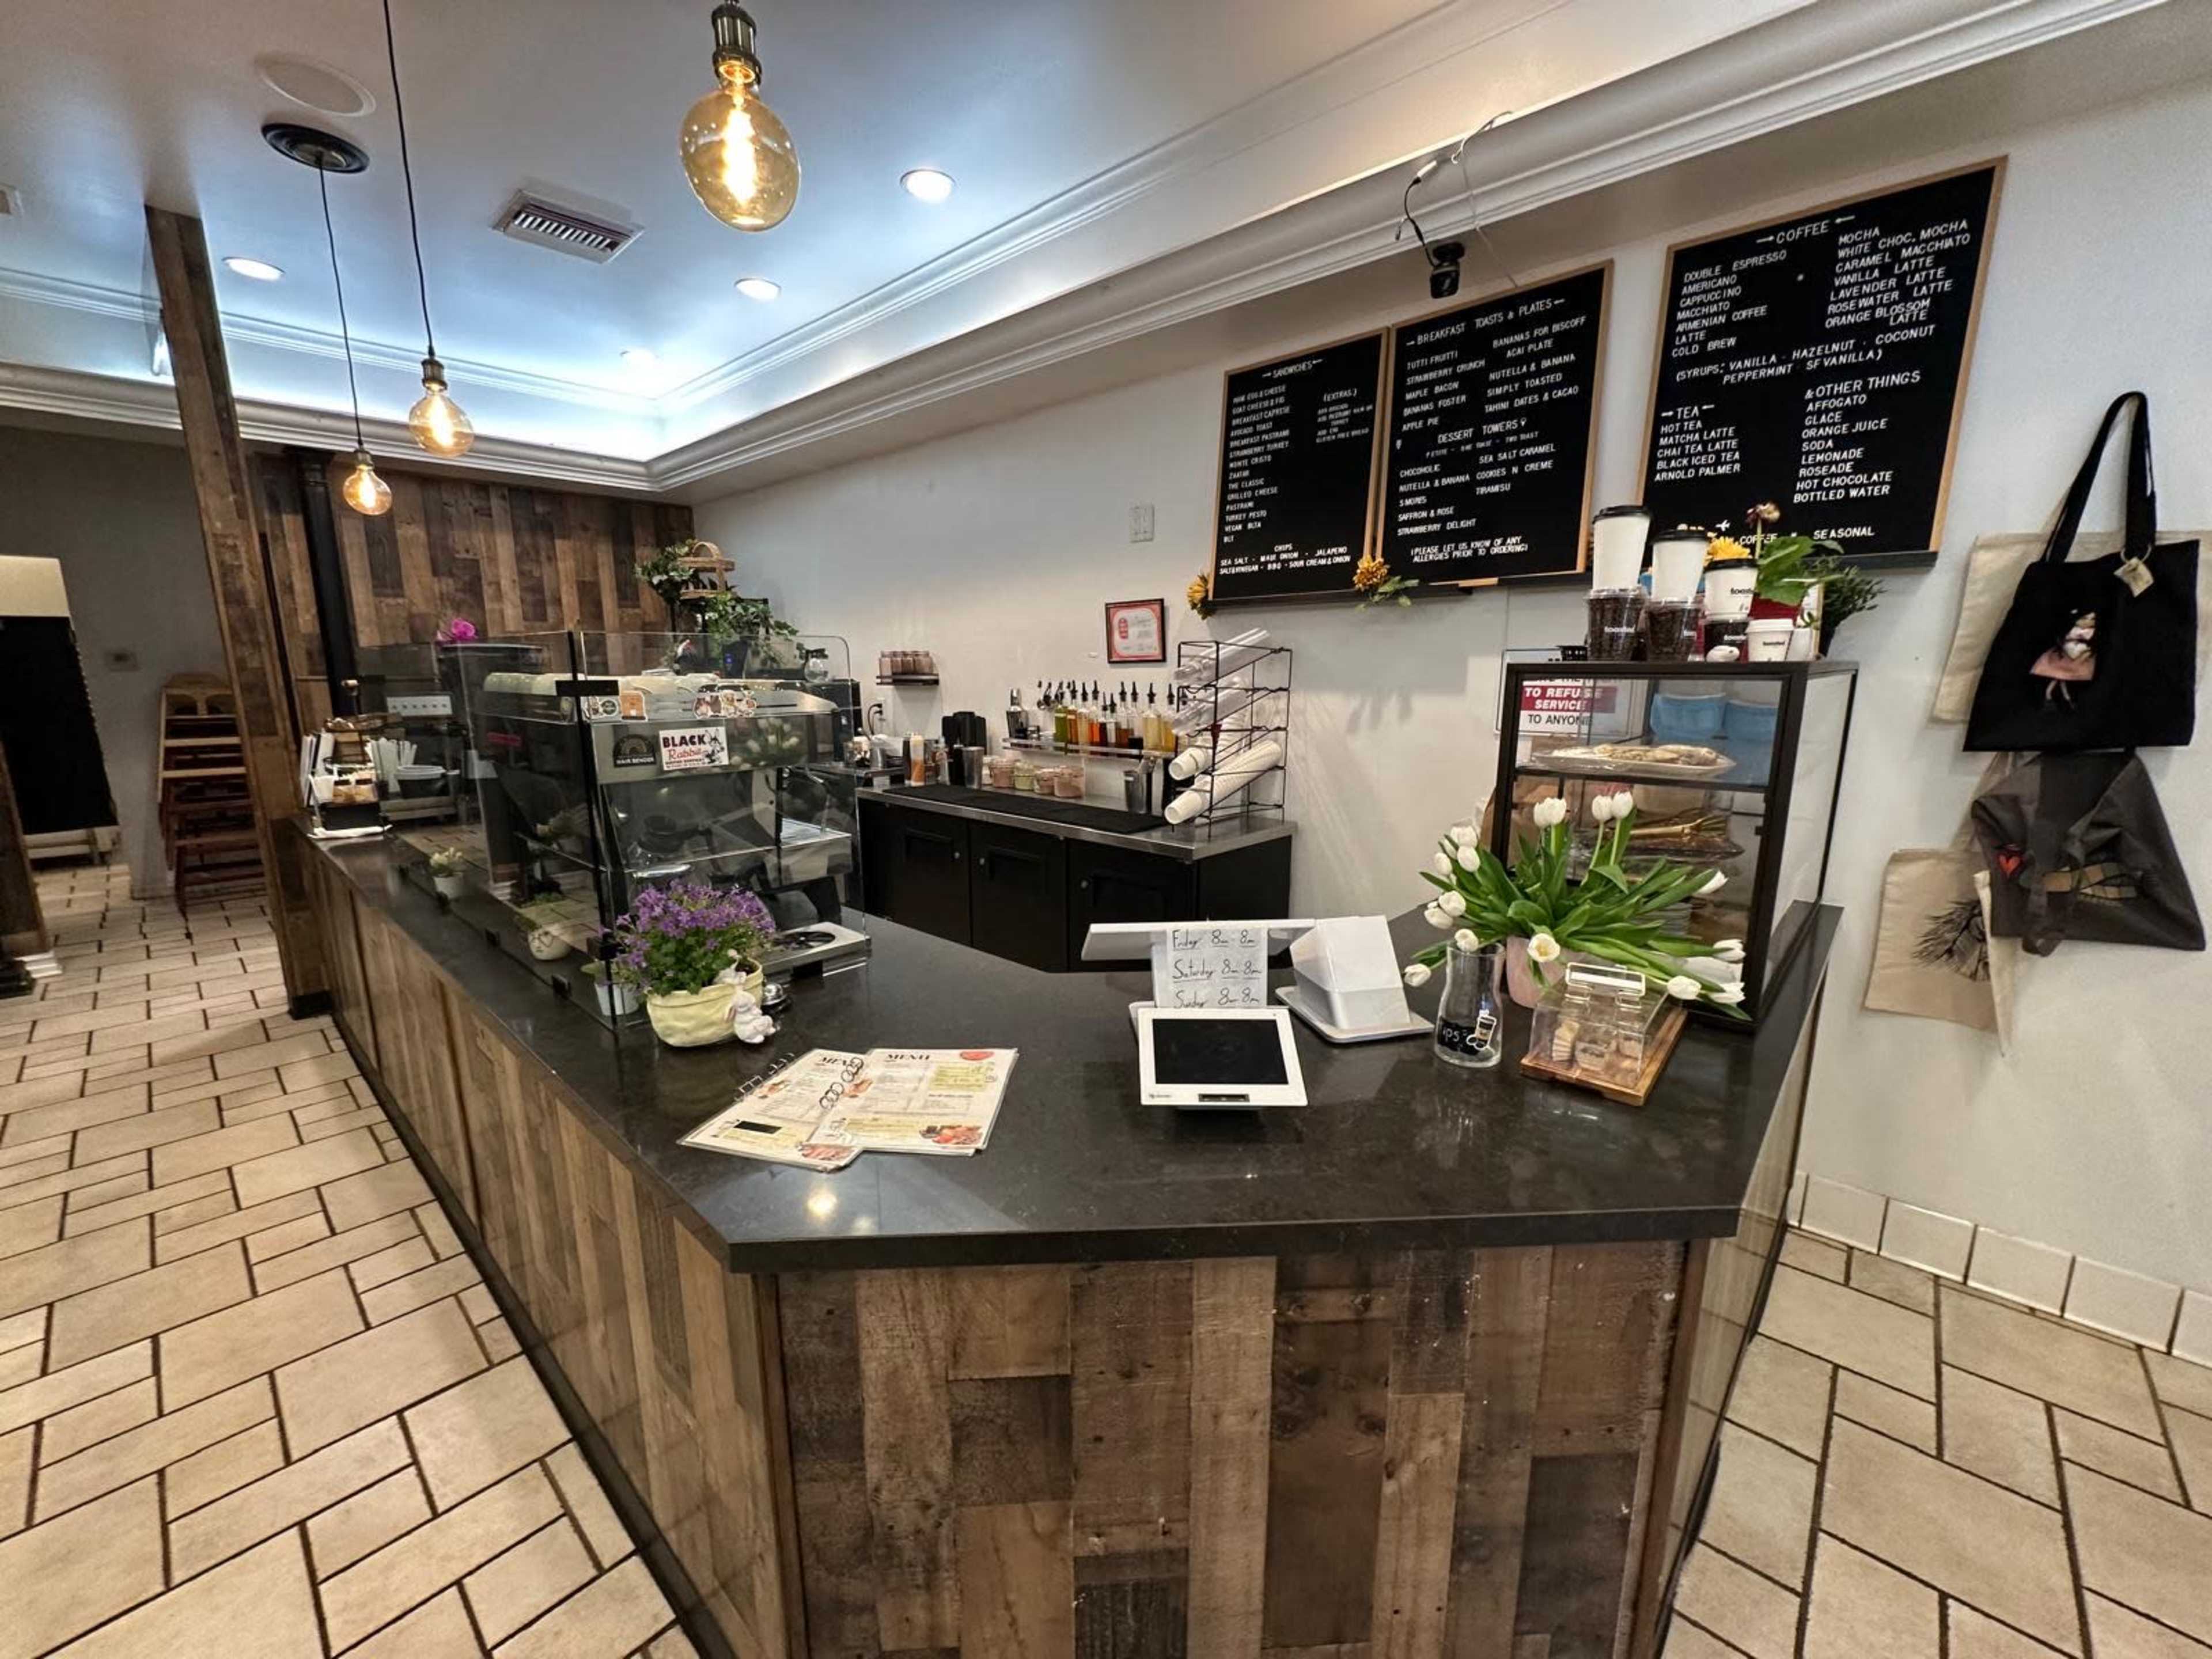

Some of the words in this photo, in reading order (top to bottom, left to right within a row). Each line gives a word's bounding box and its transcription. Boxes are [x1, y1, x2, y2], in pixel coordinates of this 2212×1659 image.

[1776, 220, 1830, 244] COFFEE
[1838, 242, 1871, 259] WHITE
[1920, 219, 1968, 240] MOCHA
[1839, 228, 1880, 245] MOCHA
[1835, 253, 1892, 272] CARAMEL
[1902, 234, 1970, 259] MACCHIATO
[1684, 264, 1722, 282] DOUBLE
[1732, 251, 1787, 271] ESPRESSO
[1834, 268, 1880, 286] VANILLA
[1895, 256, 1935, 274] LATTE
[1681, 275, 1737, 294] AMERICANO
[1830, 278, 1897, 301] LAVENDER
[1906, 268, 1946, 286] LATTE
[1912, 280, 1953, 297] LATTE
[1679, 286, 1742, 308] CAPPUCCINO
[1676, 315, 1726, 333] ARMENIAN
[1732, 305, 1768, 321] COFFEE
[1677, 302, 1730, 320] MACCHIATO
[1825, 311, 1872, 328] ORANGE
[1875, 299, 1930, 319] BLOSSOM
[1889, 309, 1928, 325] LATTE
[1416, 321, 1467, 346] BREAKFAST
[1475, 312, 1503, 328] TOASTS
[1518, 299, 1553, 316] PLATES
[1493, 333, 1530, 349] BANANAS
[1528, 338, 1554, 352] PLATE
[1675, 331, 1706, 344] LATTE
[1672, 345, 1699, 357] COLD
[1707, 337, 1737, 351] BREW
[1729, 354, 1777, 372] VANILLA
[1792, 339, 1855, 360] HAZELNUT
[1876, 324, 1936, 344] COCONUT
[1272, 361, 1313, 378] SANDWICHES
[1407, 358, 1428, 370] TUTTI
[1456, 358, 1486, 373] CRUNCH
[1489, 365, 1527, 381] NUTELLA
[1541, 354, 1575, 369] BANANA
[1723, 363, 1791, 385] PEPPERMINT
[1868, 372, 1921, 392] THINGS
[1405, 388, 1428, 400] MAPLE
[1434, 381, 1460, 394] BACON
[1487, 382, 1520, 397] SIMPLY
[1525, 373, 1563, 389] TOASTED
[1514, 394, 1539, 408] DATES
[1551, 385, 1579, 399] CACAO
[1806, 394, 1867, 412] AFFOGATO
[1427, 416, 1439, 427] PIE
[1677, 407, 1699, 420] TEA
[1805, 411, 1843, 426] GLACE
[1437, 428, 1474, 445] DESSERT
[1482, 419, 1518, 435] TOWERS
[1661, 421, 1681, 433] HOT
[1683, 420, 1702, 431] TEA
[1802, 423, 1849, 439] ORANGE
[1852, 418, 1888, 433] JUICE
[1659, 432, 1699, 445] MATCHA
[1703, 427, 1734, 441] LATTE
[1802, 438, 1834, 452] SODA
[1479, 455, 1493, 464] SEA
[1497, 450, 1517, 461] SALT
[1519, 442, 1555, 457] CARAMEL
[1657, 446, 1681, 458] CHAI
[1685, 443, 1705, 454] TEA
[1708, 439, 1738, 452] LATTE
[1801, 448, 1863, 465] LEMONADE
[1524, 460, 1554, 472] CREME
[1657, 457, 1690, 469] BLACK
[1691, 454, 1716, 465] ICED
[1721, 452, 1740, 462] TEA
[1799, 461, 1854, 478] ROSEADE
[1441, 473, 1471, 486] BANANA
[1654, 468, 1695, 482] ARNOLD
[1698, 464, 1740, 477] PALMER
[1796, 478, 1820, 491] HOT
[1823, 471, 1893, 487] CHOCOLATE
[1793, 488, 1845, 503] BOTTLED
[1850, 484, 1891, 498] WATER
[1398, 510, 1427, 522] SAFFRON
[1446, 518, 1477, 531] DELIGHT
[1813, 525, 1874, 539] SEASONAL
[1442, 543, 1456, 552] LET
[1506, 536, 1522, 545] ANY
[1452, 548, 1473, 558] PRIOR
[1234, 556, 1248, 565] SALT
[1525, 687, 1541, 697] TO
[1546, 688, 1603, 699] REFUSE
[1528, 714, 1541, 724] TO
[662, 734, 707, 748] BLACK
